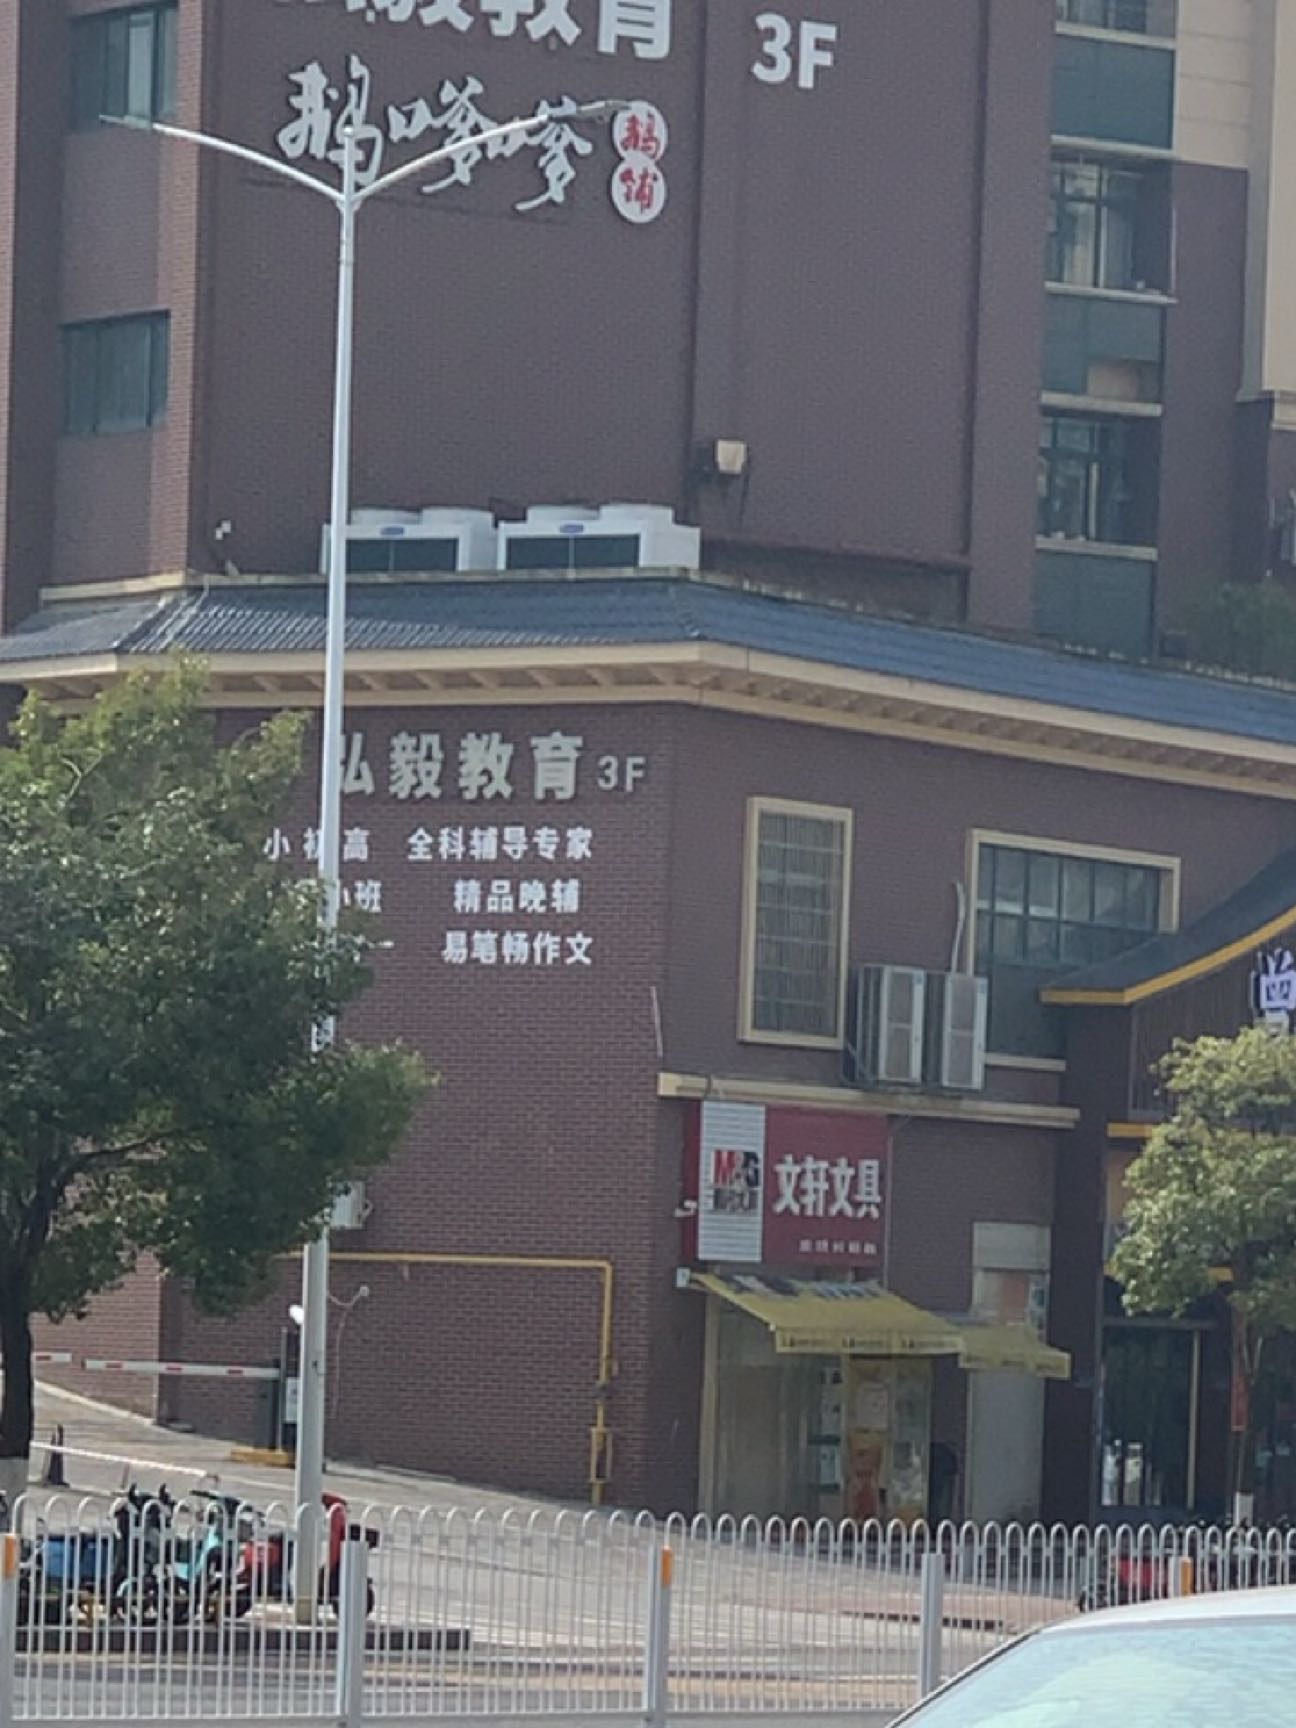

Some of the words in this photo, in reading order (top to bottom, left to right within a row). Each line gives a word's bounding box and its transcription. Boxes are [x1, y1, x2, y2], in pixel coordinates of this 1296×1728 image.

[752, 14, 838, 88] 3F
[598, 755, 647, 792] 3F
[407, 826, 593, 861] 全科辅导专家
[453, 878, 580, 913] 精品晚辅
[772, 1153, 882, 1220] 文轩文具
